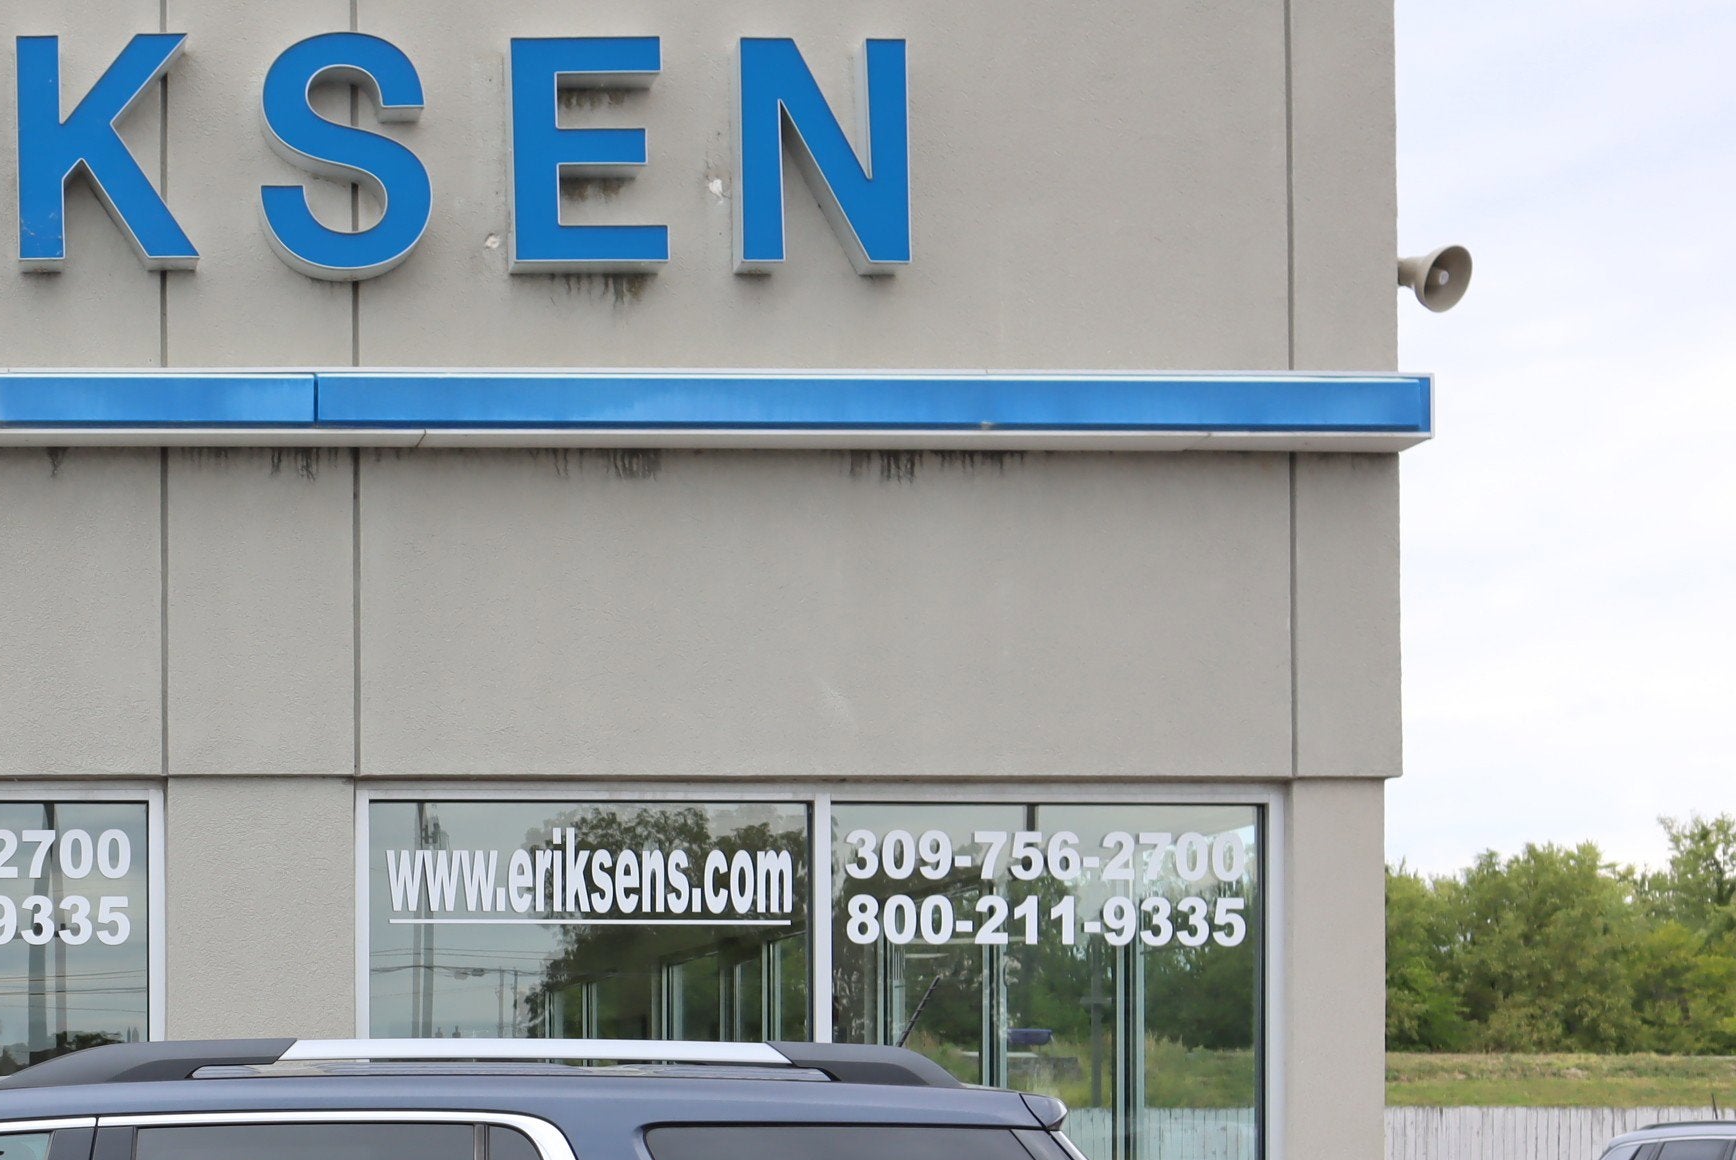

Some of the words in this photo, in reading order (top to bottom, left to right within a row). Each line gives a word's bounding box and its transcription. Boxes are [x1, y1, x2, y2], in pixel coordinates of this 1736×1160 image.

[387, 828, 792, 915] www.eriksens.com
[845, 829, 1244, 882] 309-756-2700
[846, 894, 1247, 947] 800-211-9335
